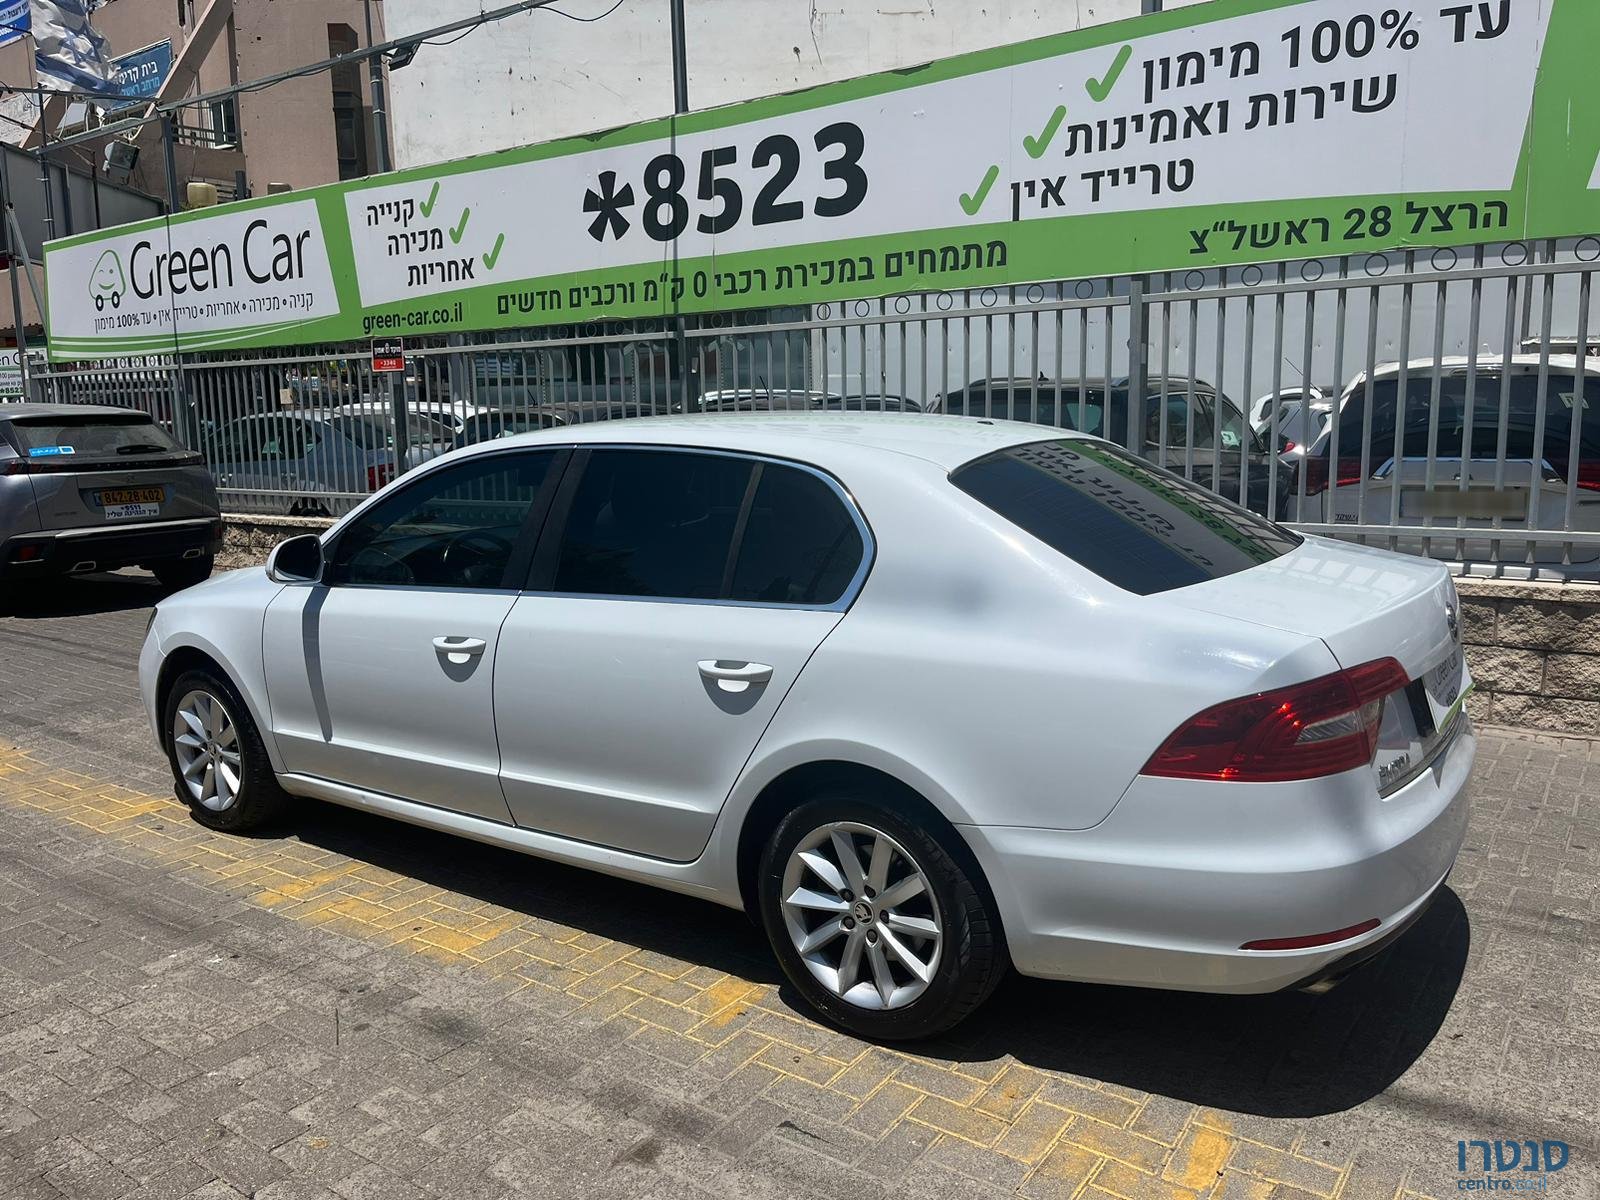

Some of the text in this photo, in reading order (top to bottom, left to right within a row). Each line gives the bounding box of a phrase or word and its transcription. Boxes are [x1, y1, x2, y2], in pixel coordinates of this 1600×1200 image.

[1143, 0, 1510, 104] עד 100% מימון
[141, 62, 158, 77] בית
[1065, 73, 1397, 157] שירות ואמינות
[1011, 158, 1194, 221] טרייד אין
[366, 199, 414, 227] קנייה
[1343, 205, 1392, 240] 28
[1405, 200, 1507, 234] הרצל
[387, 228, 443, 256] מכירה
[130, 219, 311, 299] Green Car
[407, 258, 475, 287] אחריות
[775, 256, 875, 290] במכירת
[885, 240, 1007, 278] מתמחים
[569, 282, 635, 308] ורכבים
[693, 271, 707, 298] 0
[714, 269, 767, 296] רכבי
[94, 292, 313, 334] קניה מכירה אחריות טרייד אין עד 100% מימון
[363, 302, 463, 334] green-car.co.il
[497, 289, 562, 315] חדשים
